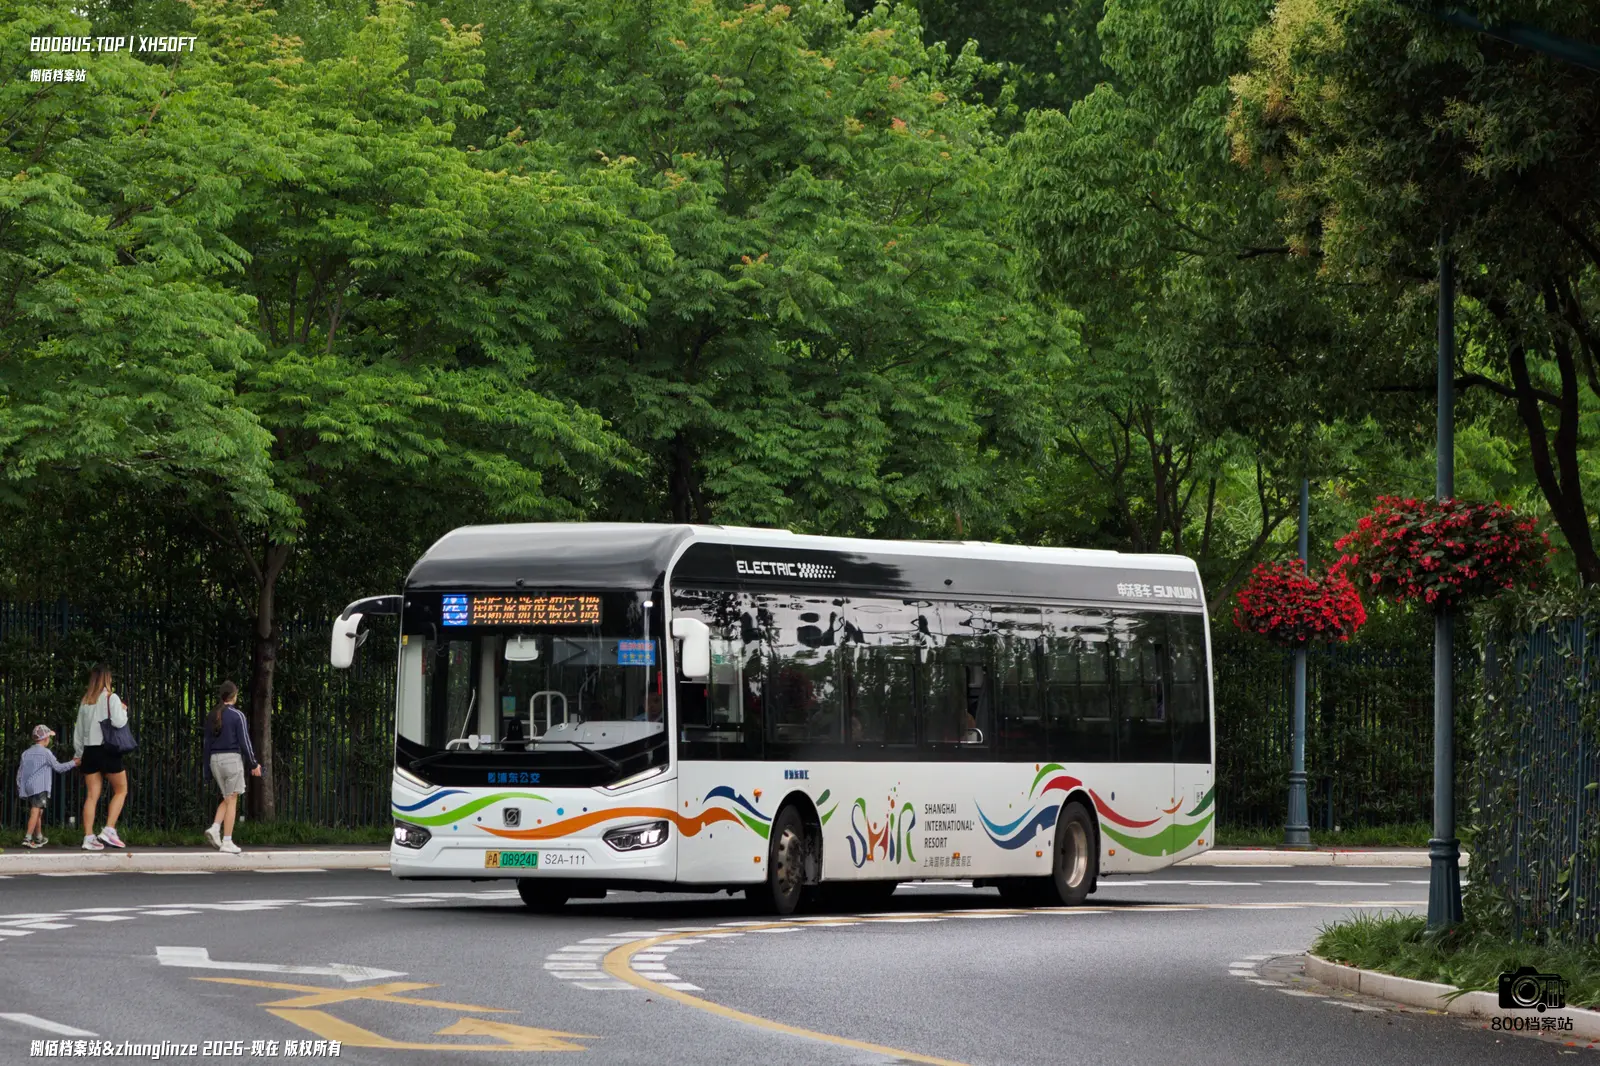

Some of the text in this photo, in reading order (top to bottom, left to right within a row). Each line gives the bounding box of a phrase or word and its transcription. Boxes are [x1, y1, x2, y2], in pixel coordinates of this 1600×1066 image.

[736, 560, 797, 576] ELECTRIC
[1153, 585, 1198, 600] SUNWIN
[924, 803, 957, 815] SHANGHAI
[924, 820, 973, 832] INTERNATIONAL
[924, 837, 948, 849] RESORT
[544, 854, 585, 865] S2A-111
